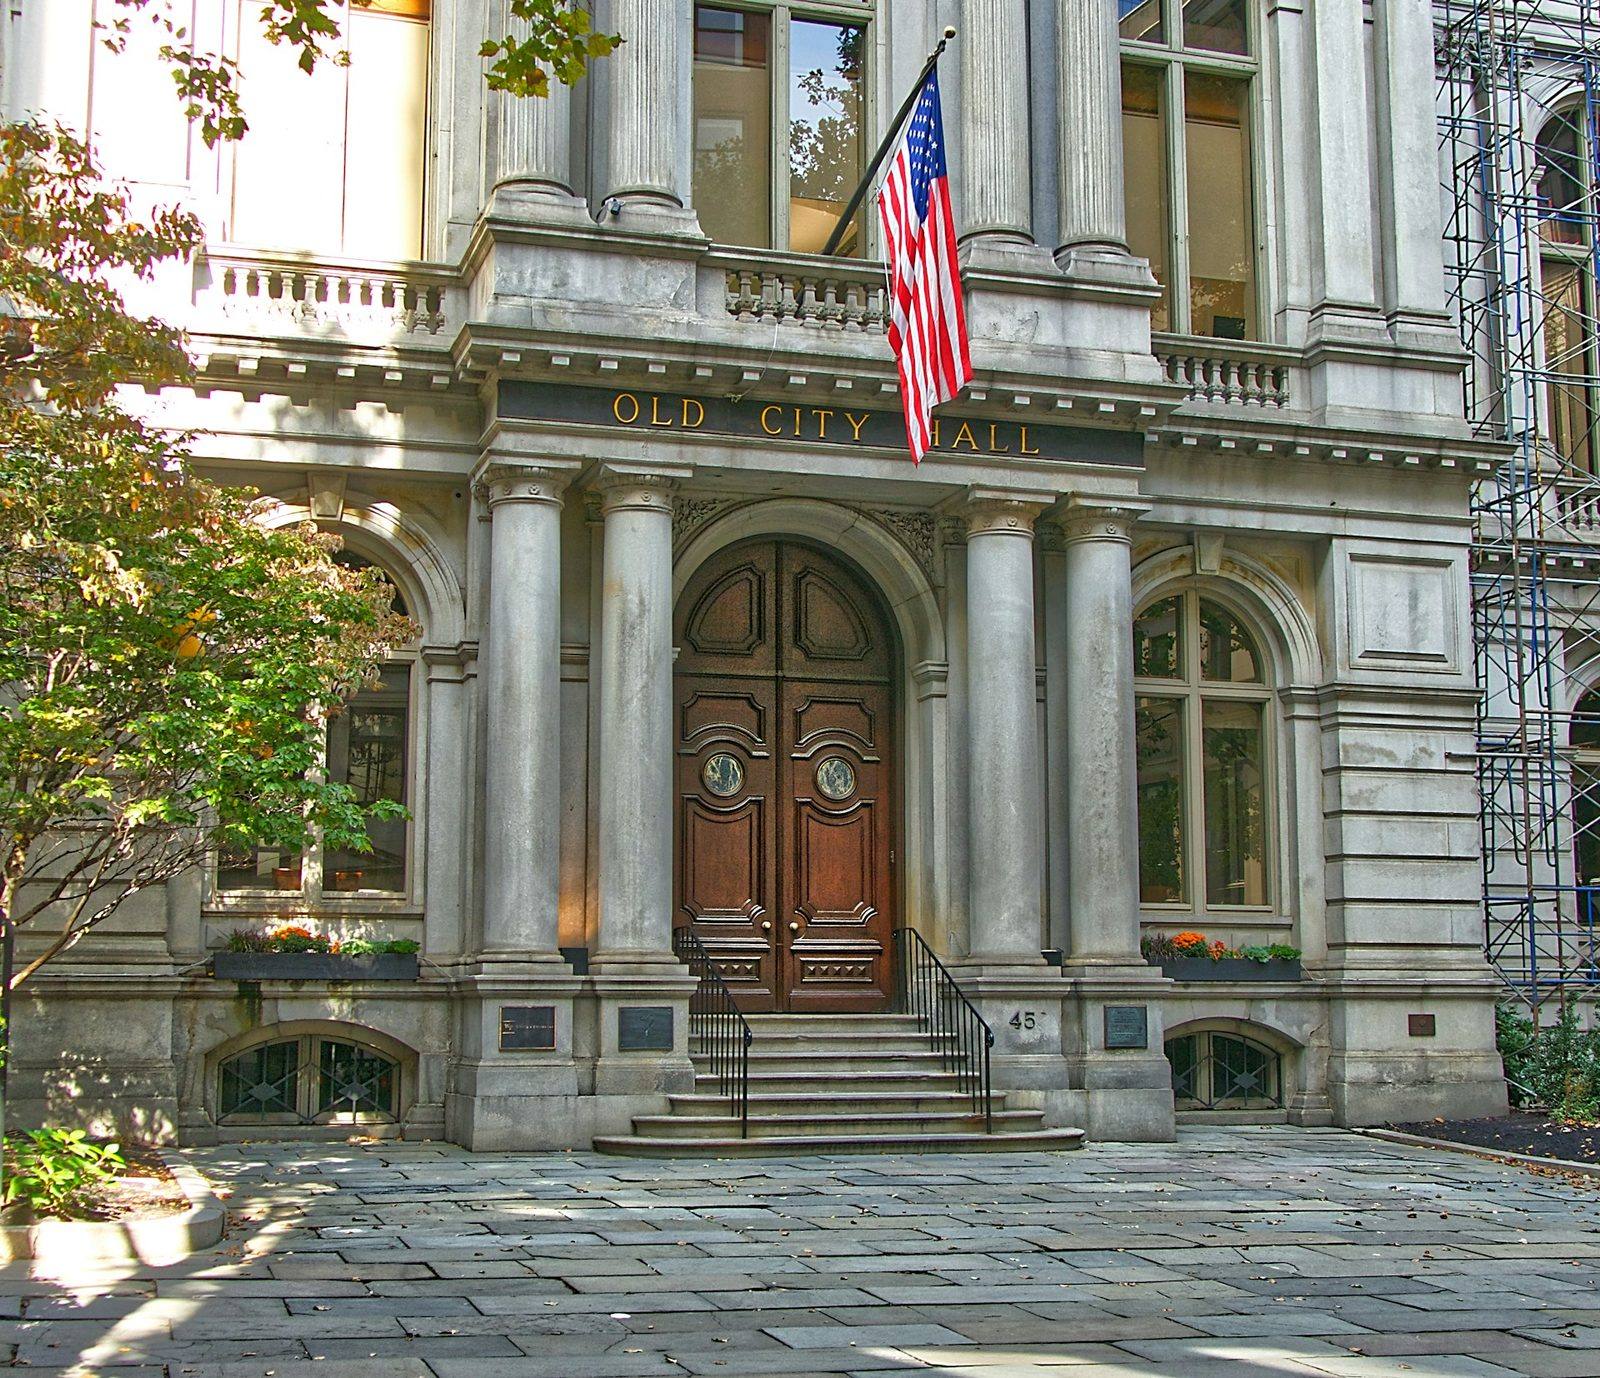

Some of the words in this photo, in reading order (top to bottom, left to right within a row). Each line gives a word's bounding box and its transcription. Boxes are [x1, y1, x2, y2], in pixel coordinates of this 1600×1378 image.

[613, 393, 704, 428] OLD
[760, 405, 871, 441] CITY
[1009, 1012, 1035, 1030] 45
